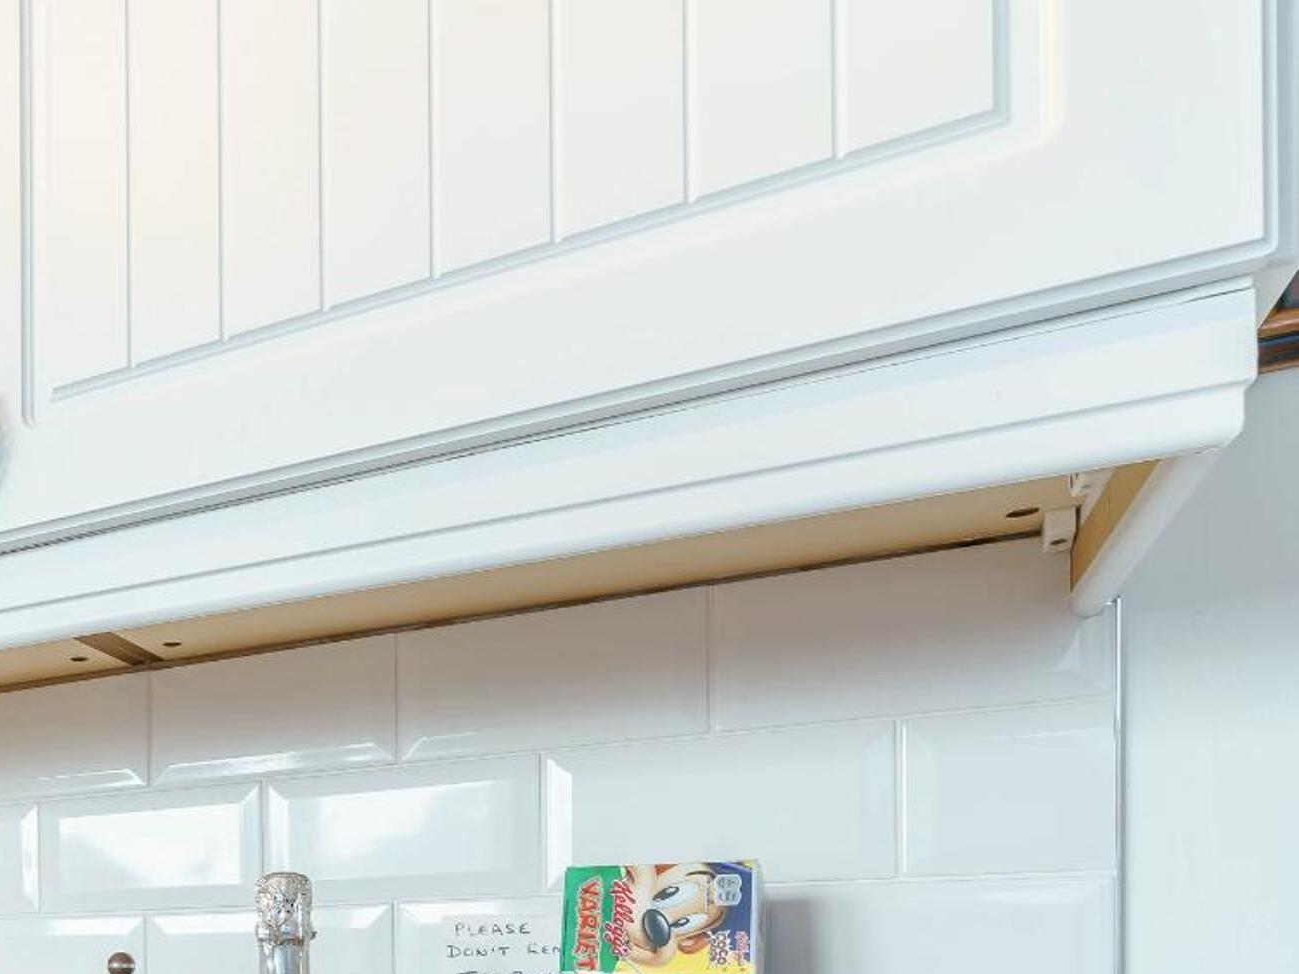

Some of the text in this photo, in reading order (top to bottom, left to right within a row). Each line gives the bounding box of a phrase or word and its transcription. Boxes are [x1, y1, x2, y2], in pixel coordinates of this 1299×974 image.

[603, 880, 636, 956] Kellogg's
[455, 922, 531, 937] PLEASE
[446, 944, 510, 958] DON'T
